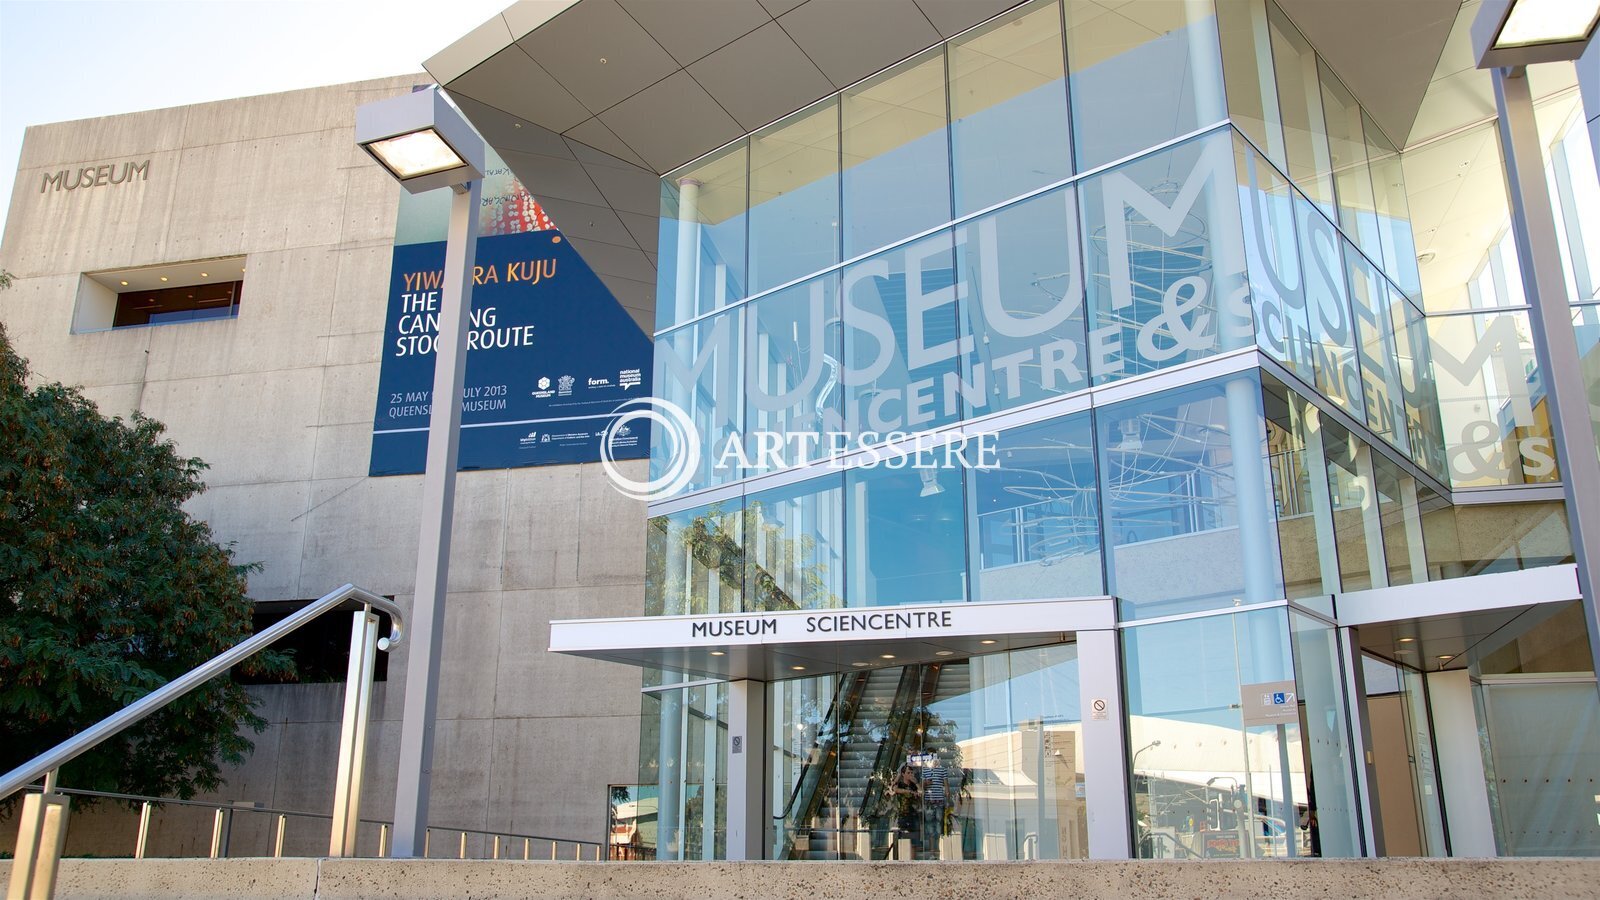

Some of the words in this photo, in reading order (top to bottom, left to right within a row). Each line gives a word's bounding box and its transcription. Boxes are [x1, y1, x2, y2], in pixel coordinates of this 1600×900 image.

[40, 159, 151, 194] MUSEUM
[403, 264, 499, 292] YIWRA
[507, 258, 557, 285] KUJU
[401, 291, 438, 313] THE
[652, 137, 1252, 450] MUSEUM
[398, 307, 496, 335] CANNG
[1138, 275, 1217, 362] &
[466, 325, 535, 350] ROUTE
[390, 393, 403, 404] 25
[405, 391, 429, 403] MAY
[463, 386, 482, 398] ULY
[483, 385, 507, 397] 2013
[461, 399, 507, 412] MUSEUM
[691, 618, 777, 638] MUSEUM
[806, 611, 952, 633] SCIENCENTRE
